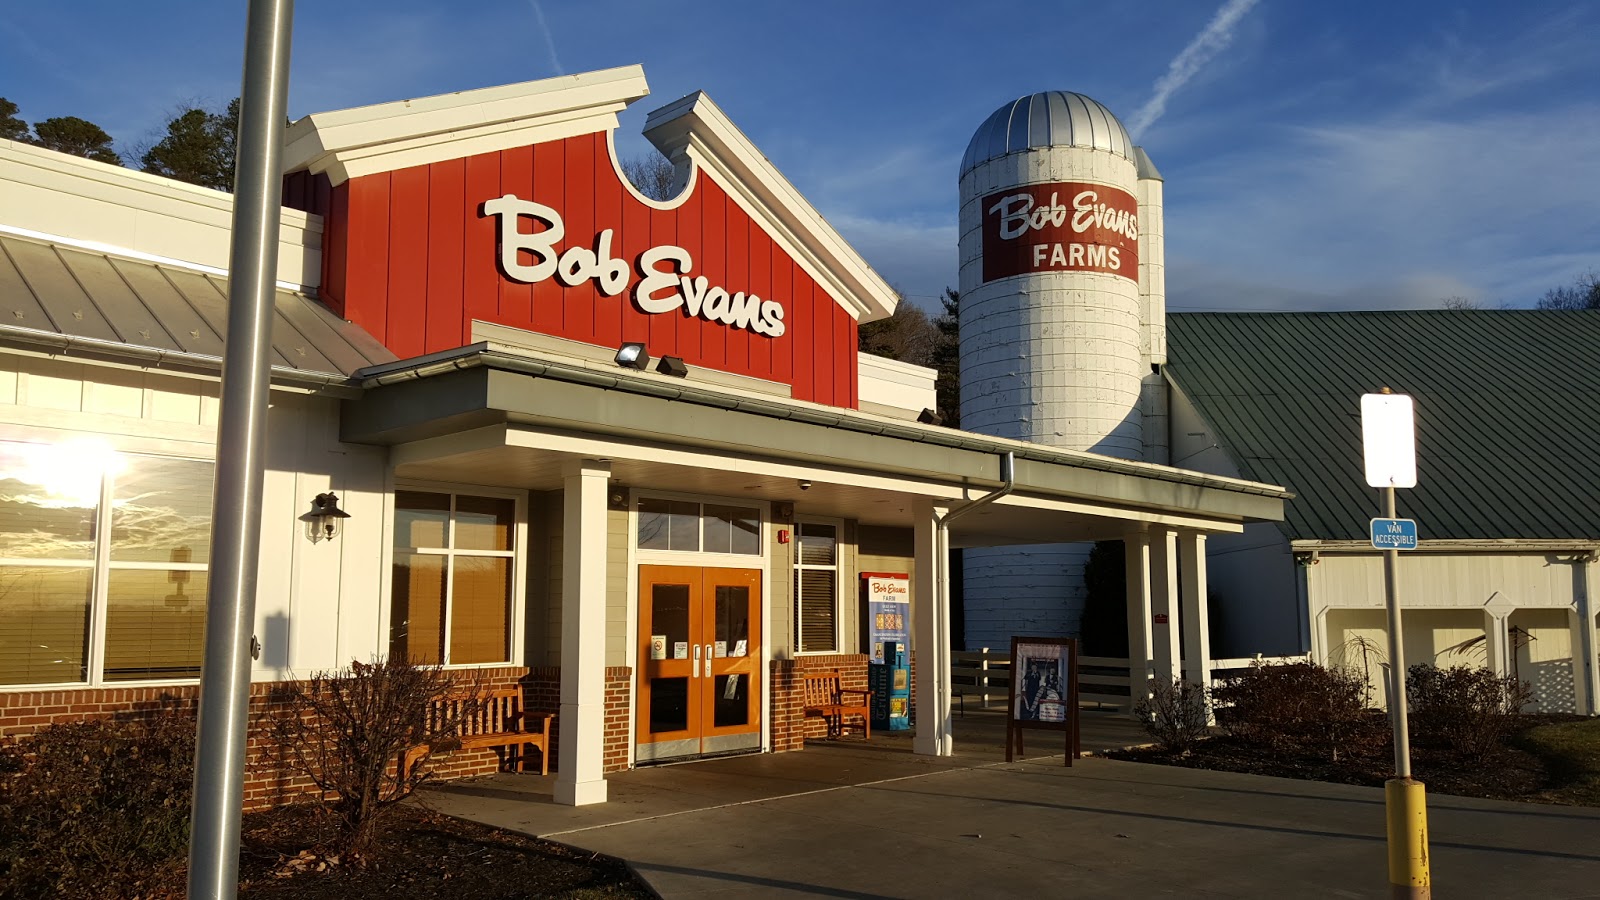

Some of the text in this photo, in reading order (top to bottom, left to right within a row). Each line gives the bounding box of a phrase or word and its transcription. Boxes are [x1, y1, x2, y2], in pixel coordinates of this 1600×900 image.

[989, 191, 1137, 241] Bob Evans
[484, 194, 785, 337] Bob Evans
[1033, 243, 1121, 270] FARMS
[1387, 524, 1402, 533] VAN
[1375, 535, 1414, 544] ACCESSIBLE
[872, 583, 906, 594] Bob Evans
